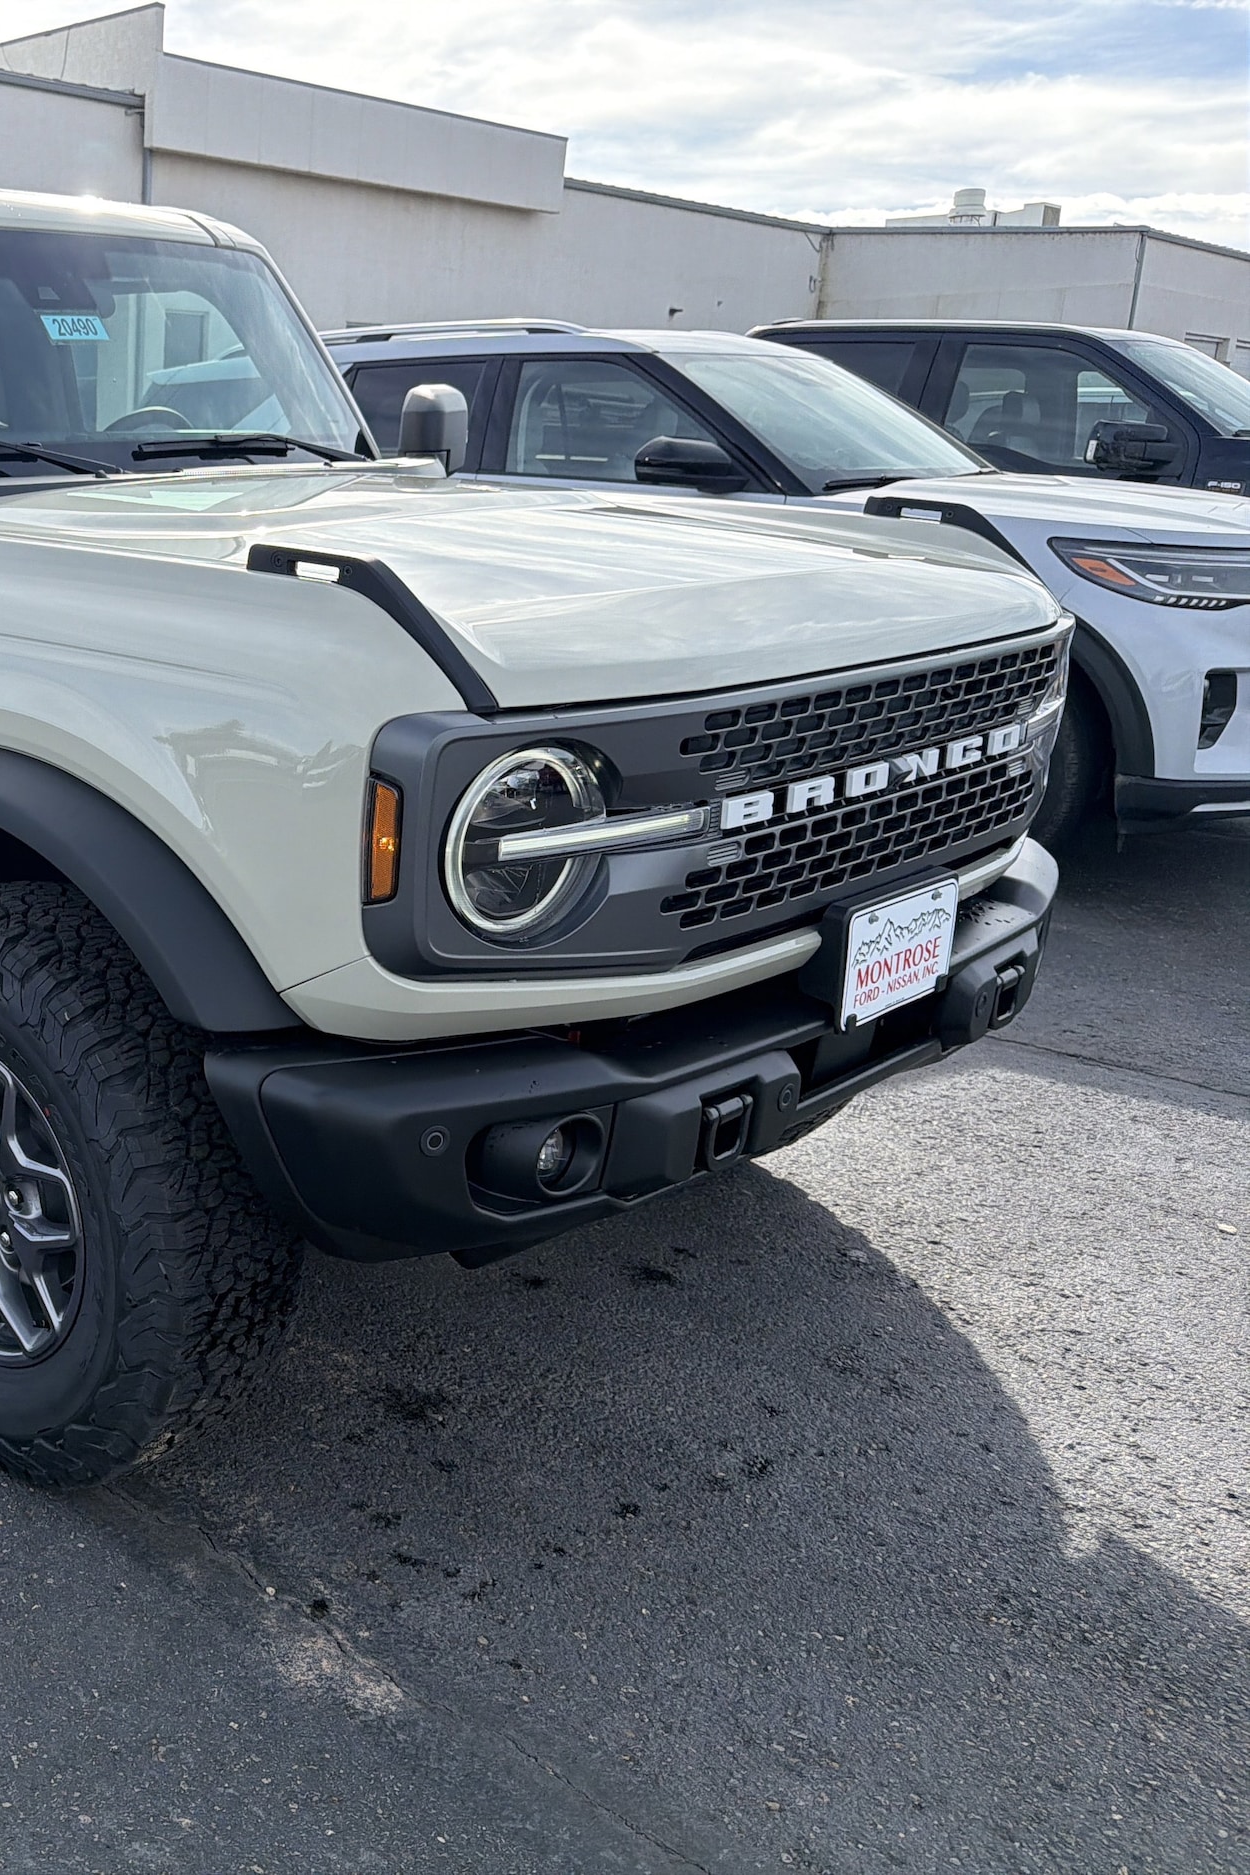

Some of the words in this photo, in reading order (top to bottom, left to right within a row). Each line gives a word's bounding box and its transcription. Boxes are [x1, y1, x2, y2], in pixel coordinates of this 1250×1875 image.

[52, 317, 98, 337] 20490
[1207, 480, 1241, 489] F-150
[720, 723, 1021, 830] BRONCO
[853, 986, 880, 1009] FORD
[886, 968, 921, 995] NISSAN,
[922, 961, 939, 979] INC.
[855, 935, 942, 992] MONTROSE
